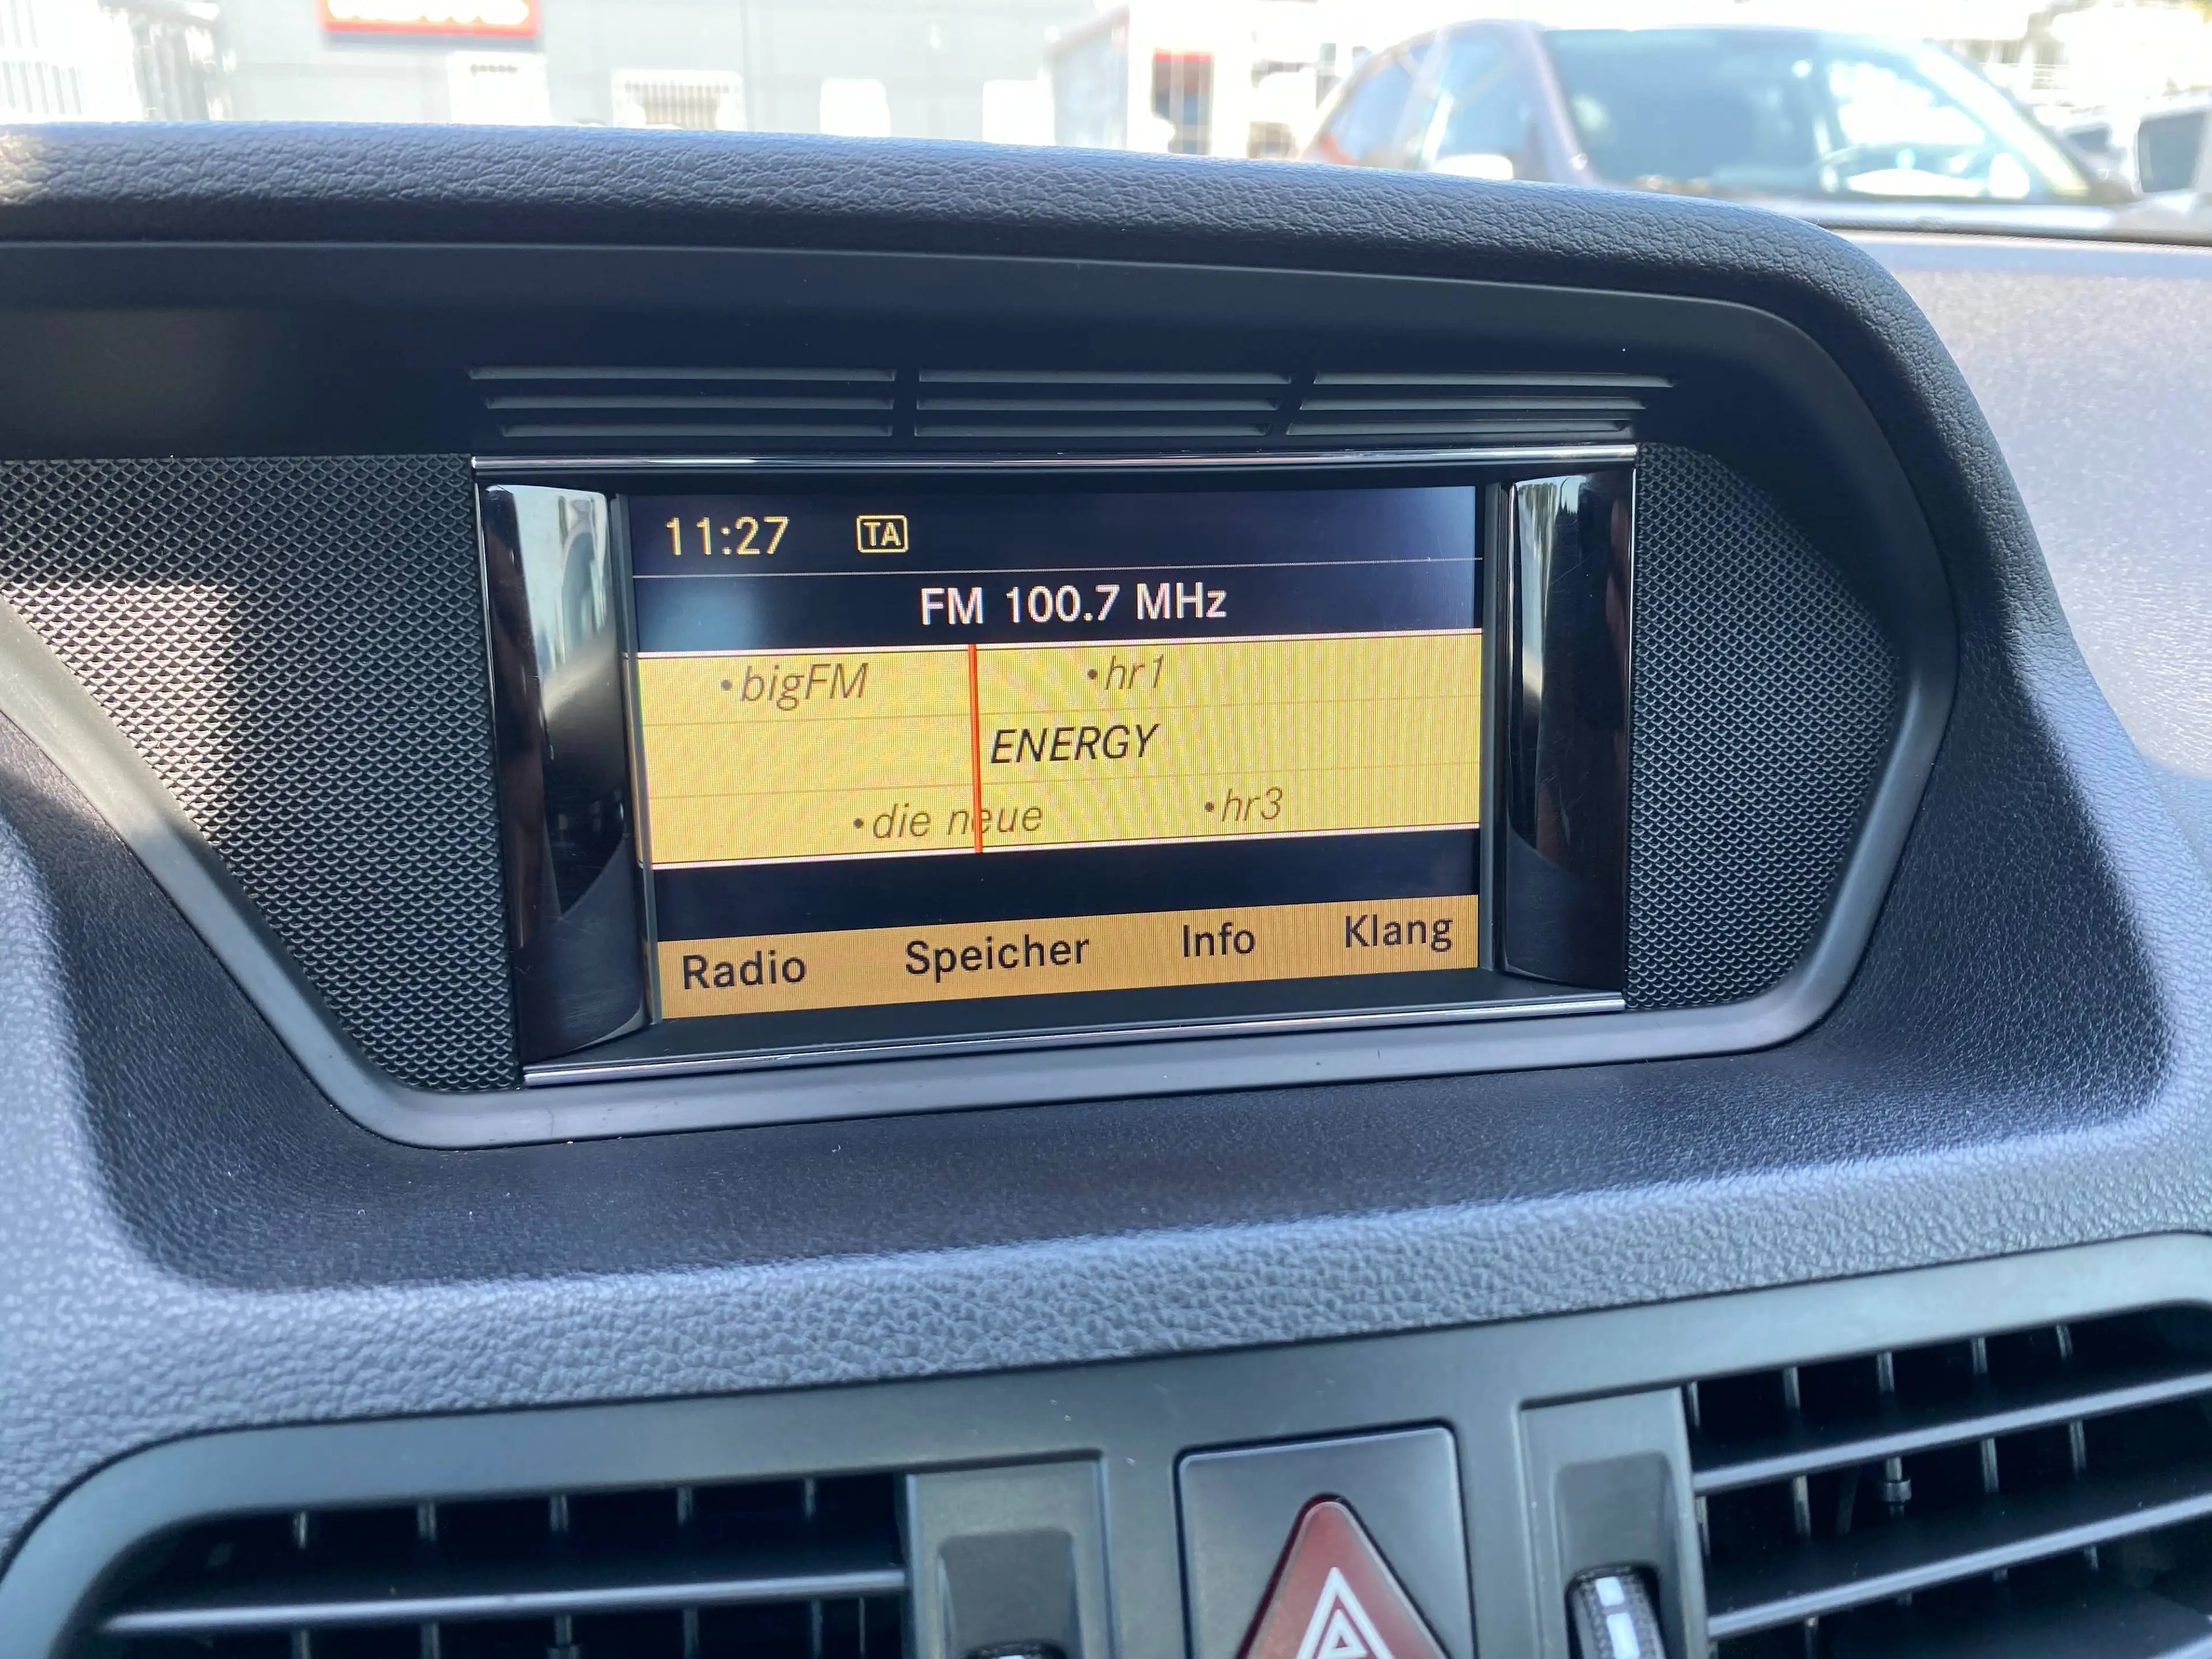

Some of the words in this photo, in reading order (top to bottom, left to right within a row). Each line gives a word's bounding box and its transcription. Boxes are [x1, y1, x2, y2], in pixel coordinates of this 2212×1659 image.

[666, 516, 789, 555] 11:27
[863, 521, 902, 547] TA
[921, 586, 984, 625] FM
[1006, 584, 1119, 623] 100.7
[1136, 581, 1227, 620] MHz
[741, 662, 869, 711] bigFM
[1104, 654, 1165, 691] hr1
[990, 724, 1159, 764] ENERGY
[872, 802, 931, 839] die
[1219, 787, 1284, 823] hr3
[1183, 922, 1255, 958] Info
[1344, 914, 1453, 952] Klang
[682, 950, 806, 990] Radio
[905, 934, 1090, 983] Speicher
